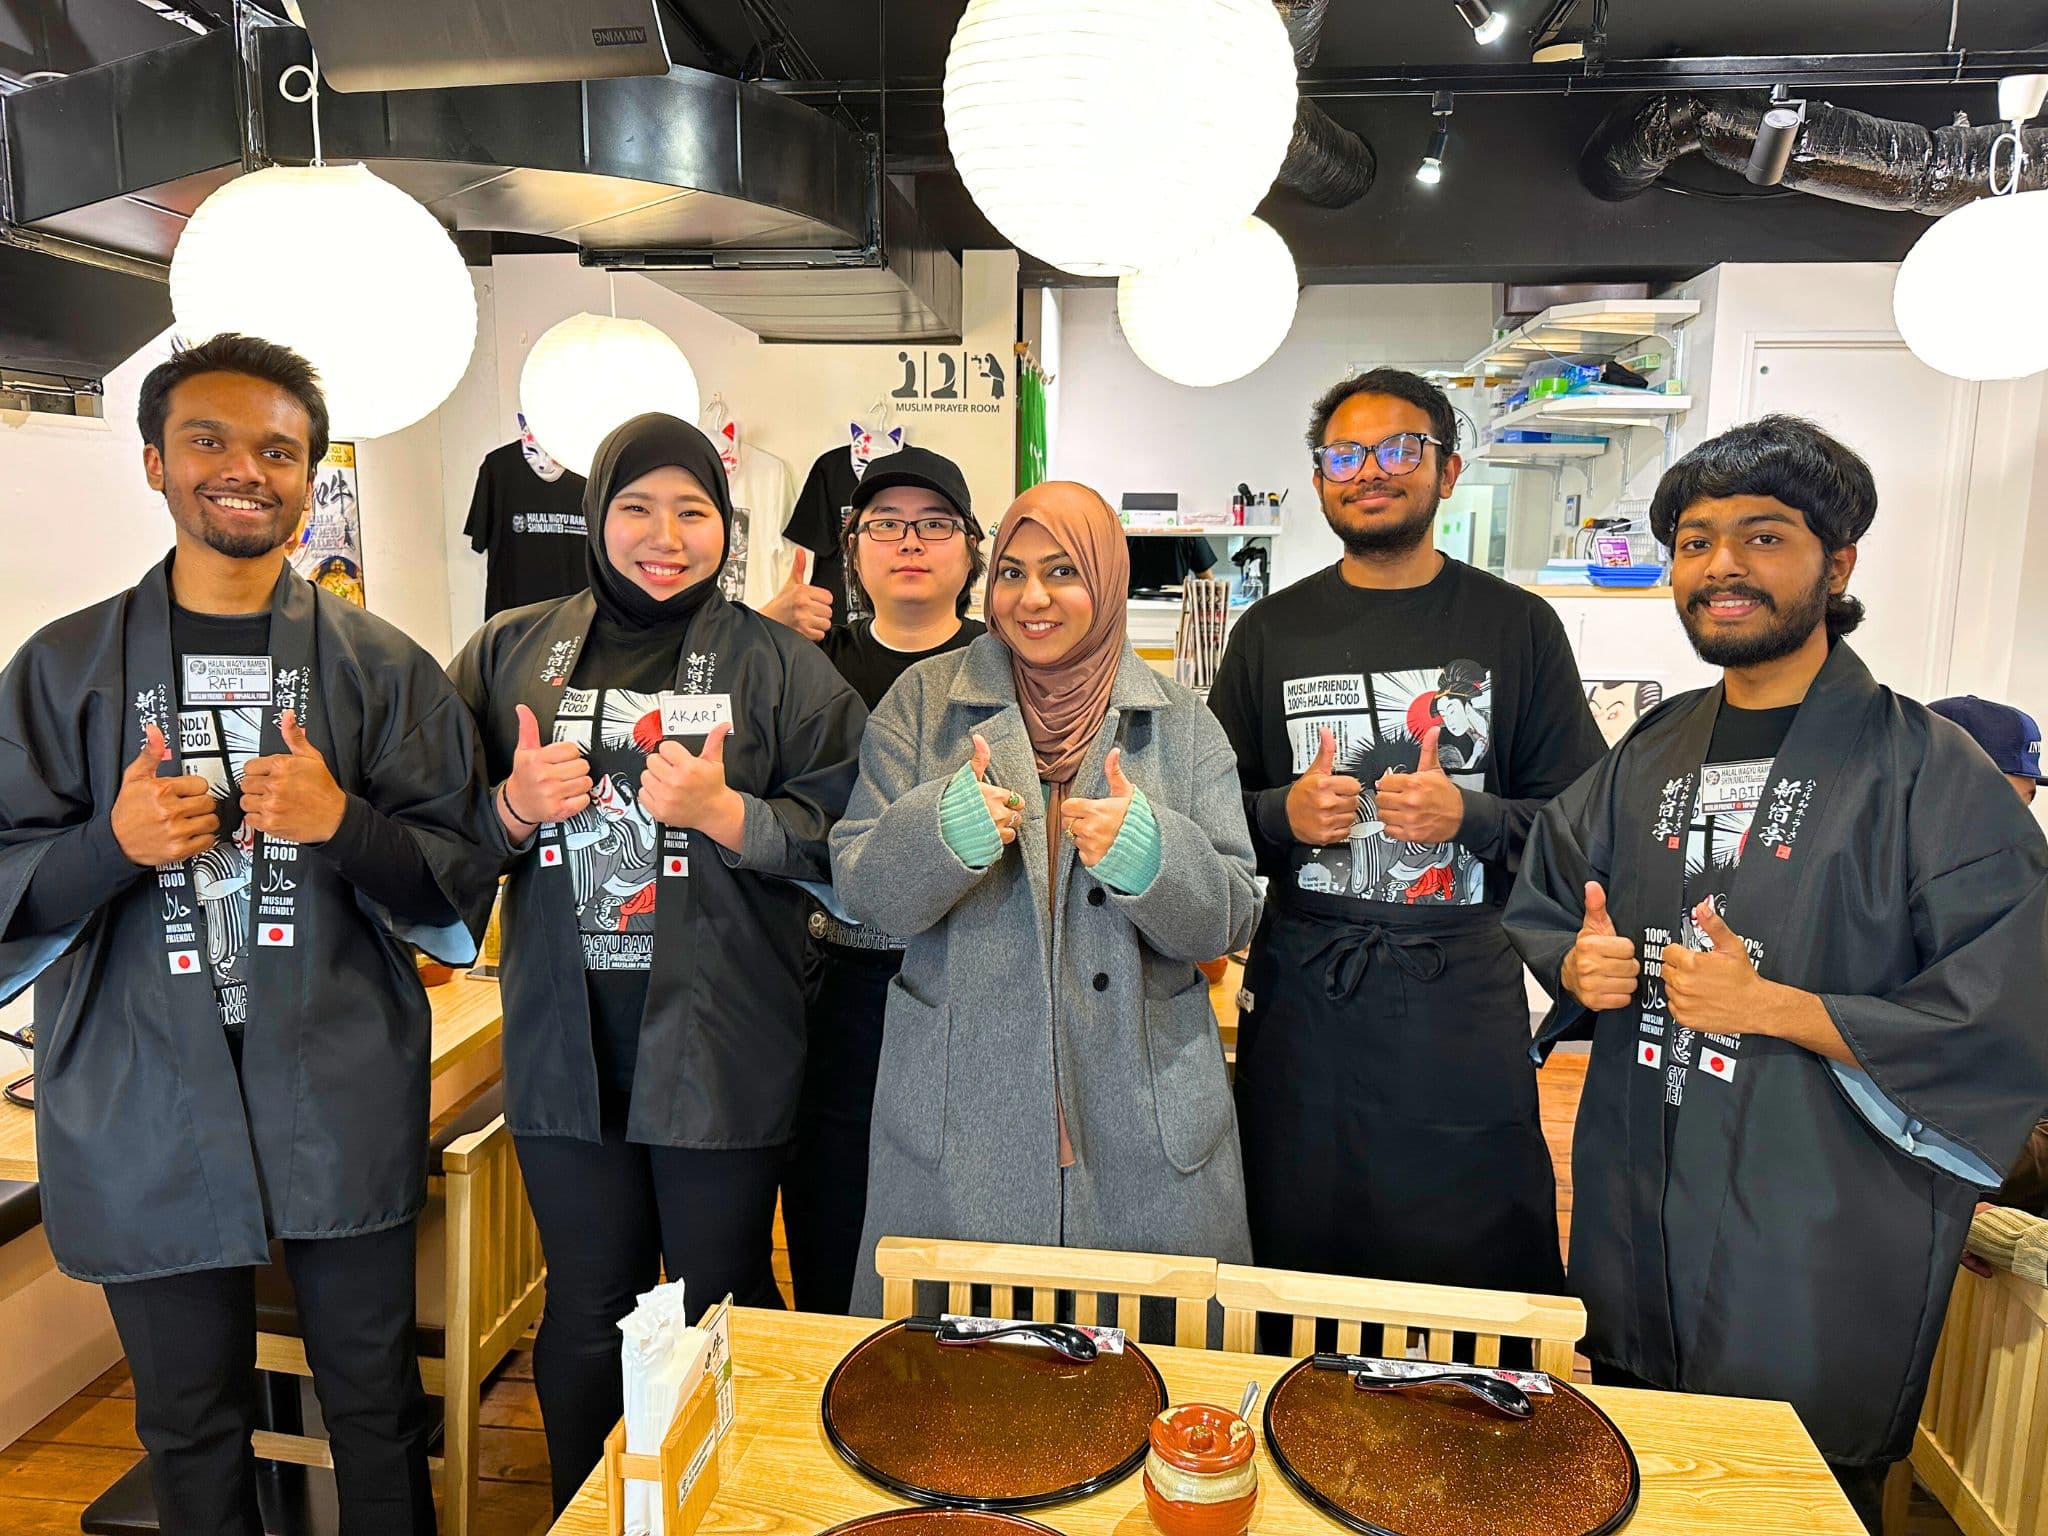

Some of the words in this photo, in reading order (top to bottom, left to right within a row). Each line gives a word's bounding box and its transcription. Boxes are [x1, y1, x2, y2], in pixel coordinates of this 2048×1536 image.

[594, 31, 626, 43] WING
[625, 30, 643, 41] AIR
[896, 403, 932, 412] MUSLIM
[934, 404, 968, 413] PRAYER
[970, 404, 1000, 413] ROOM
[527, 512, 548, 523] HALAL
[548, 513, 569, 524] WAGYU
[527, 523, 563, 534] SHINJUKUTEI
[208, 660, 226, 668] HALAL
[226, 660, 246, 668] WAGYU
[247, 660, 267, 668] RAMEN
[206, 676, 244, 690] RAFI
[1287, 682, 1317, 697] MUSLIM
[1317, 679, 1359, 692] FRIENDLY
[562, 701, 589, 713] FOOD
[1288, 697, 1307, 710] 100%
[1307, 694, 1334, 707] HALAL
[1335, 693, 1360, 705] FOOD
[134, 689, 158, 751] 新宿
[668, 709, 718, 723] AKARI
[180, 733, 211, 748] FOOD
[1651, 777, 1683, 842] 新宿亭
[1758, 777, 1802, 847] 新宿亭
[665, 831, 688, 840] MUSLIM
[664, 840, 689, 850] FRIENDLY
[263, 845, 298, 862] FOOD
[158, 872, 186, 888] FOOD
[260, 863, 297, 892] حلال
[162, 891, 192, 921] حلال
[261, 895, 294, 906] MUSLIM
[259, 905, 296, 916] FRIENDLY
[166, 922, 193, 934] MUSLIM
[165, 932, 196, 944] FRIENDLY
[1644, 927, 1672, 944] 100%
[580, 934, 621, 953] AGYU
[1737, 935, 1764, 958] 0%
[1641, 979, 1667, 1009] حلال
[1642, 1013, 1664, 1026] MUSLIM
[1640, 1023, 1665, 1037] FRIENDLY
[1704, 1031, 1742, 1050] FRIENDLY
